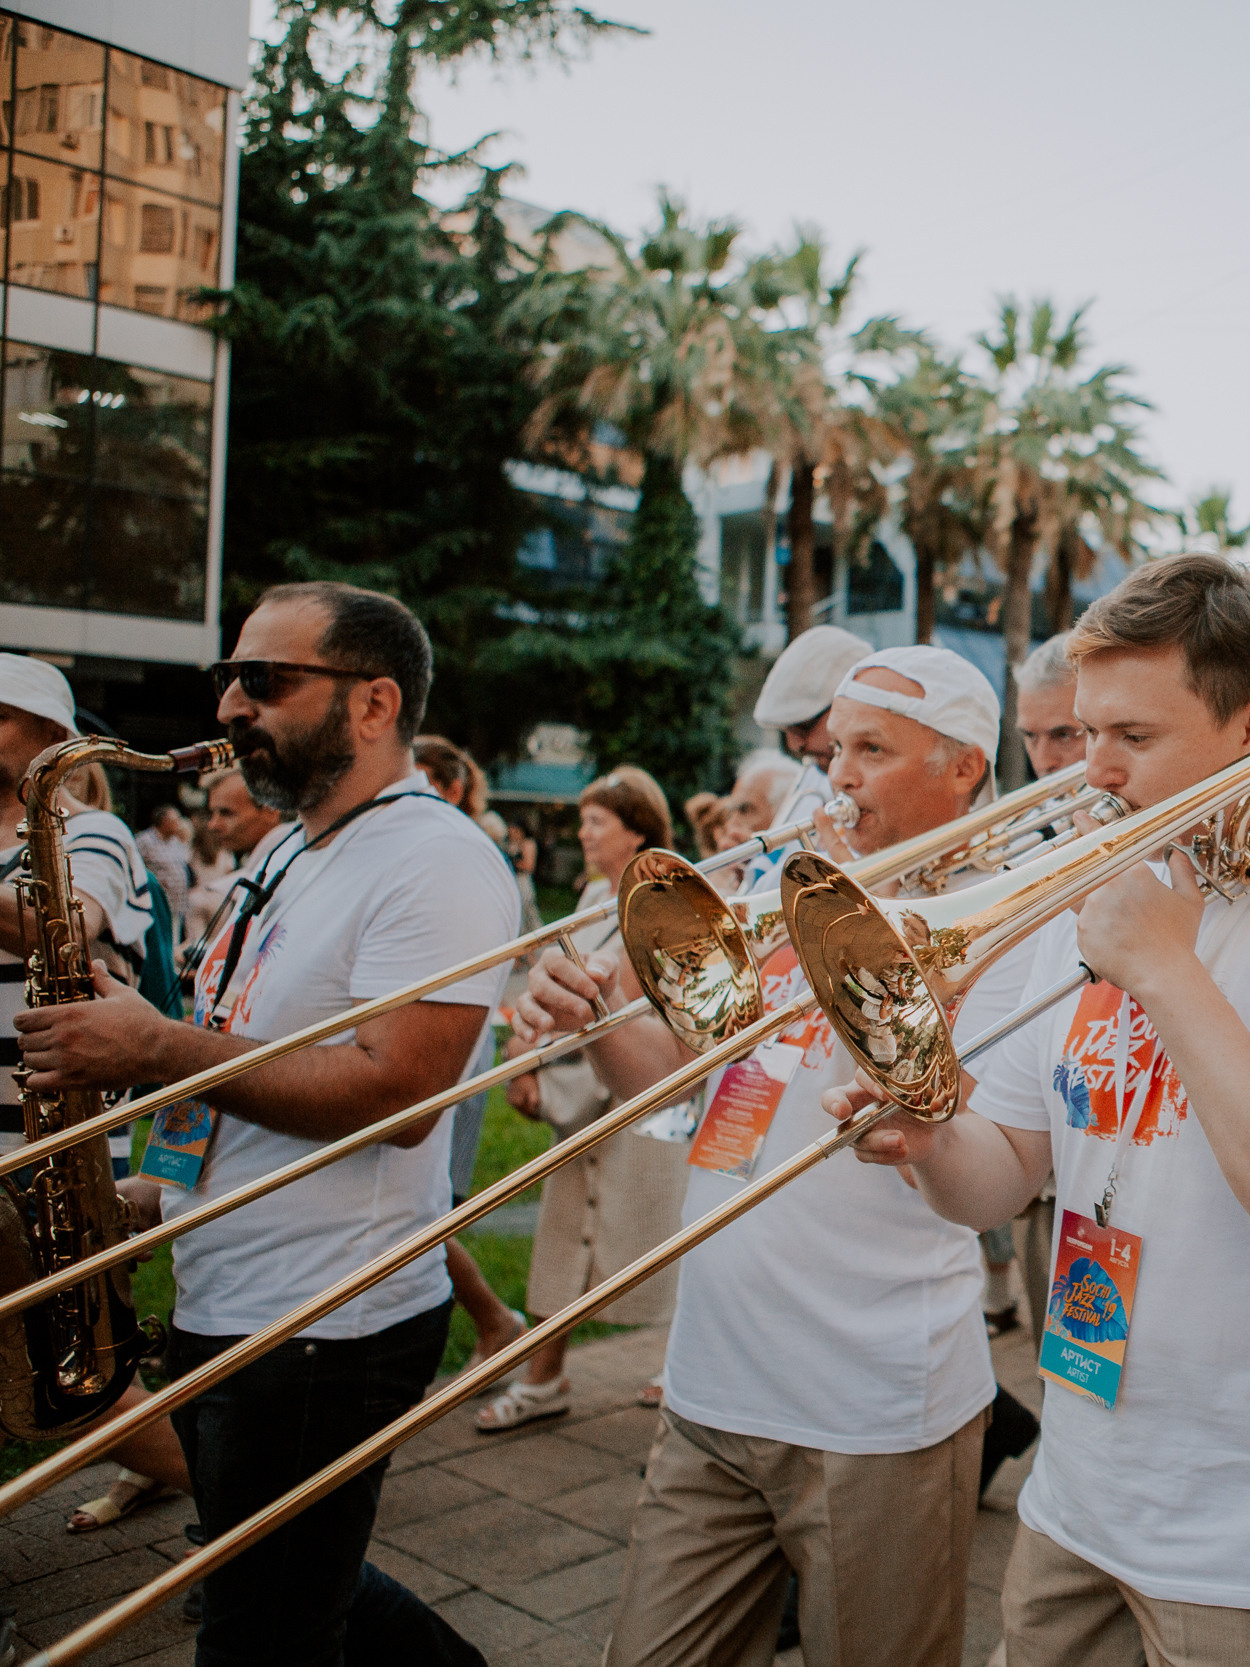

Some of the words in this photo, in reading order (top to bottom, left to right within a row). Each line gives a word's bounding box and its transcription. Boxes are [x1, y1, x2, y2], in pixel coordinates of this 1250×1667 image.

[1110, 1238, 1131, 1261] 1-4
[1064, 1282, 1095, 1310] JAZZ
[1081, 1274, 1111, 1299] SOCHI
[1063, 1303, 1101, 1327] FESTIVAL
[1061, 1347, 1101, 1374] АРТИСТ
